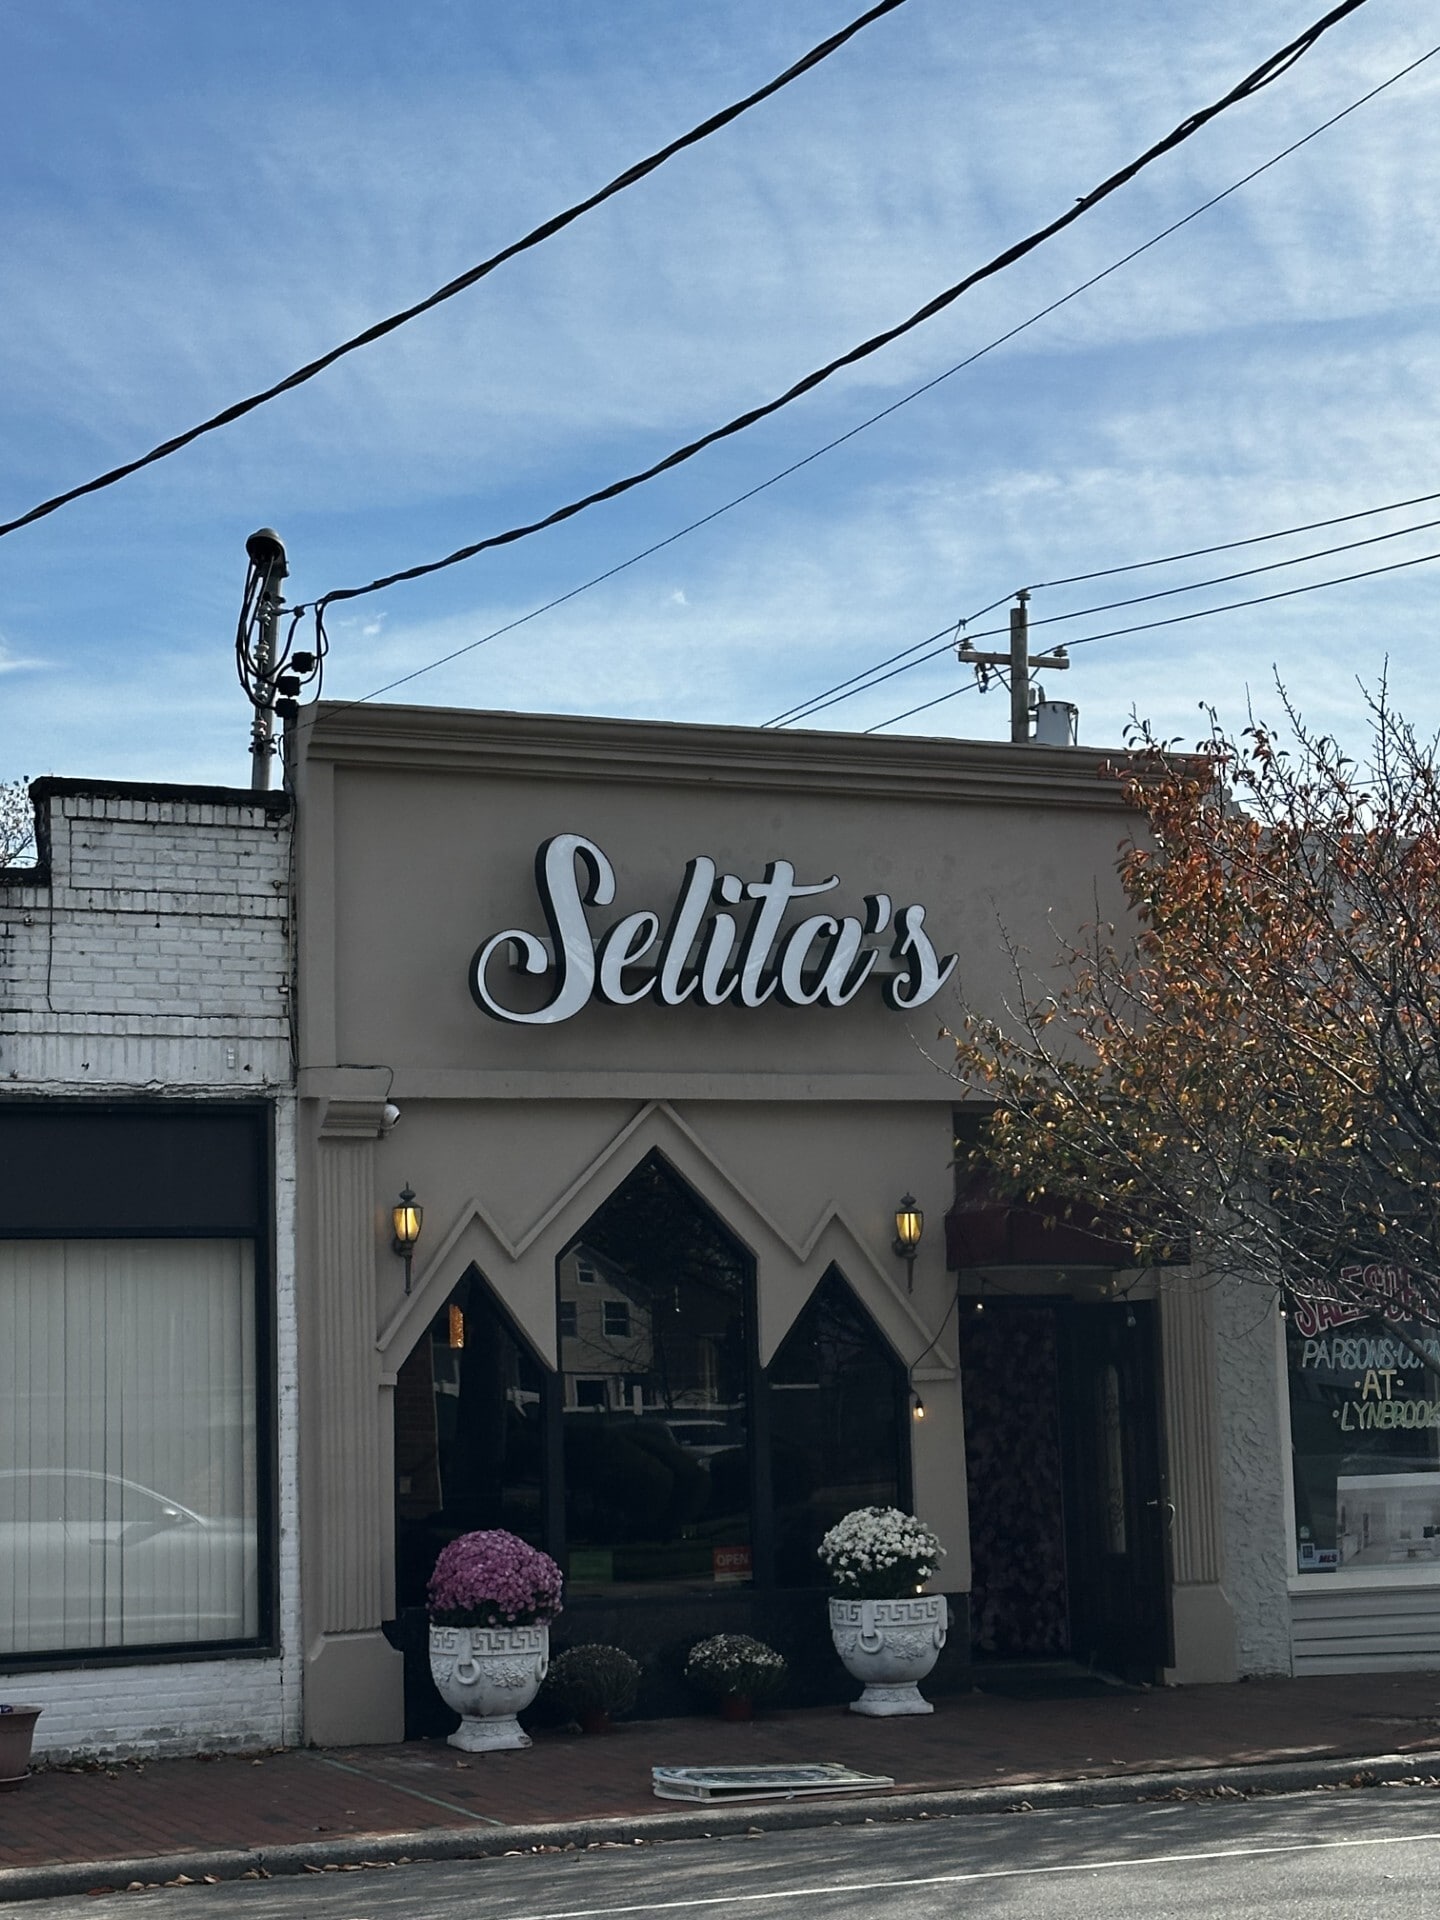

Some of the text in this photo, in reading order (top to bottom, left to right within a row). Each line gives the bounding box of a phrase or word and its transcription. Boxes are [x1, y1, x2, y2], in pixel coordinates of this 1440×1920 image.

[469, 833, 959, 1025] Selita's
[1302, 1338, 1394, 1369] PARSONS
[716, 1553, 748, 1566] OPEN
